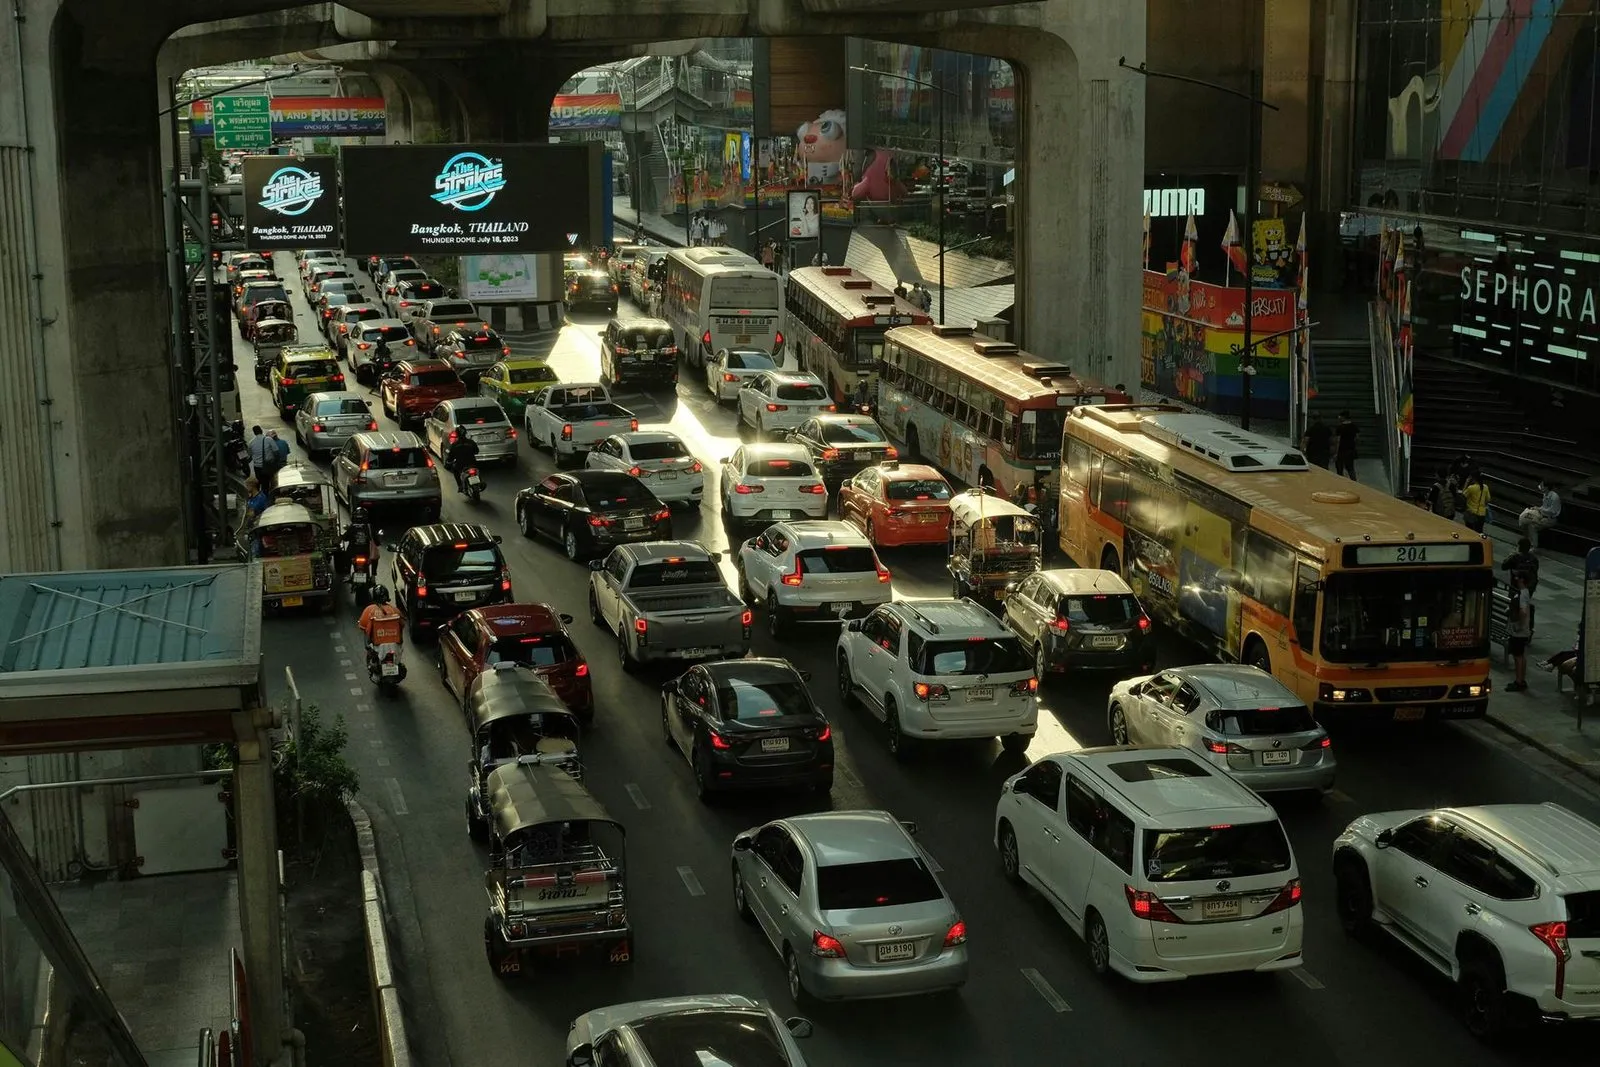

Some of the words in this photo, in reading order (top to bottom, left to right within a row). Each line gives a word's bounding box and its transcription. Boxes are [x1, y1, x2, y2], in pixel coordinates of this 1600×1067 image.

[286, 112, 308, 120] AND
[311, 108, 358, 122] PRIDE
[361, 111, 385, 120] 2023
[454, 161, 474, 176] The
[279, 175, 295, 186] The
[432, 163, 506, 204] Strokes
[259, 176, 323, 209] Strokes
[1143, 188, 1205, 217] UMA
[252, 226, 289, 235] Bangkok,
[291, 225, 334, 233] THAILAND
[410, 223, 464, 236] Bangkok,
[468, 222, 529, 233] THAILAND
[477, 236, 491, 244] July
[1460, 266, 1597, 324] SEPHORA
[1073, 395, 1092, 406] 15
[1396, 547, 1427, 562] 204
[893, 943, 912, 953] 8190
